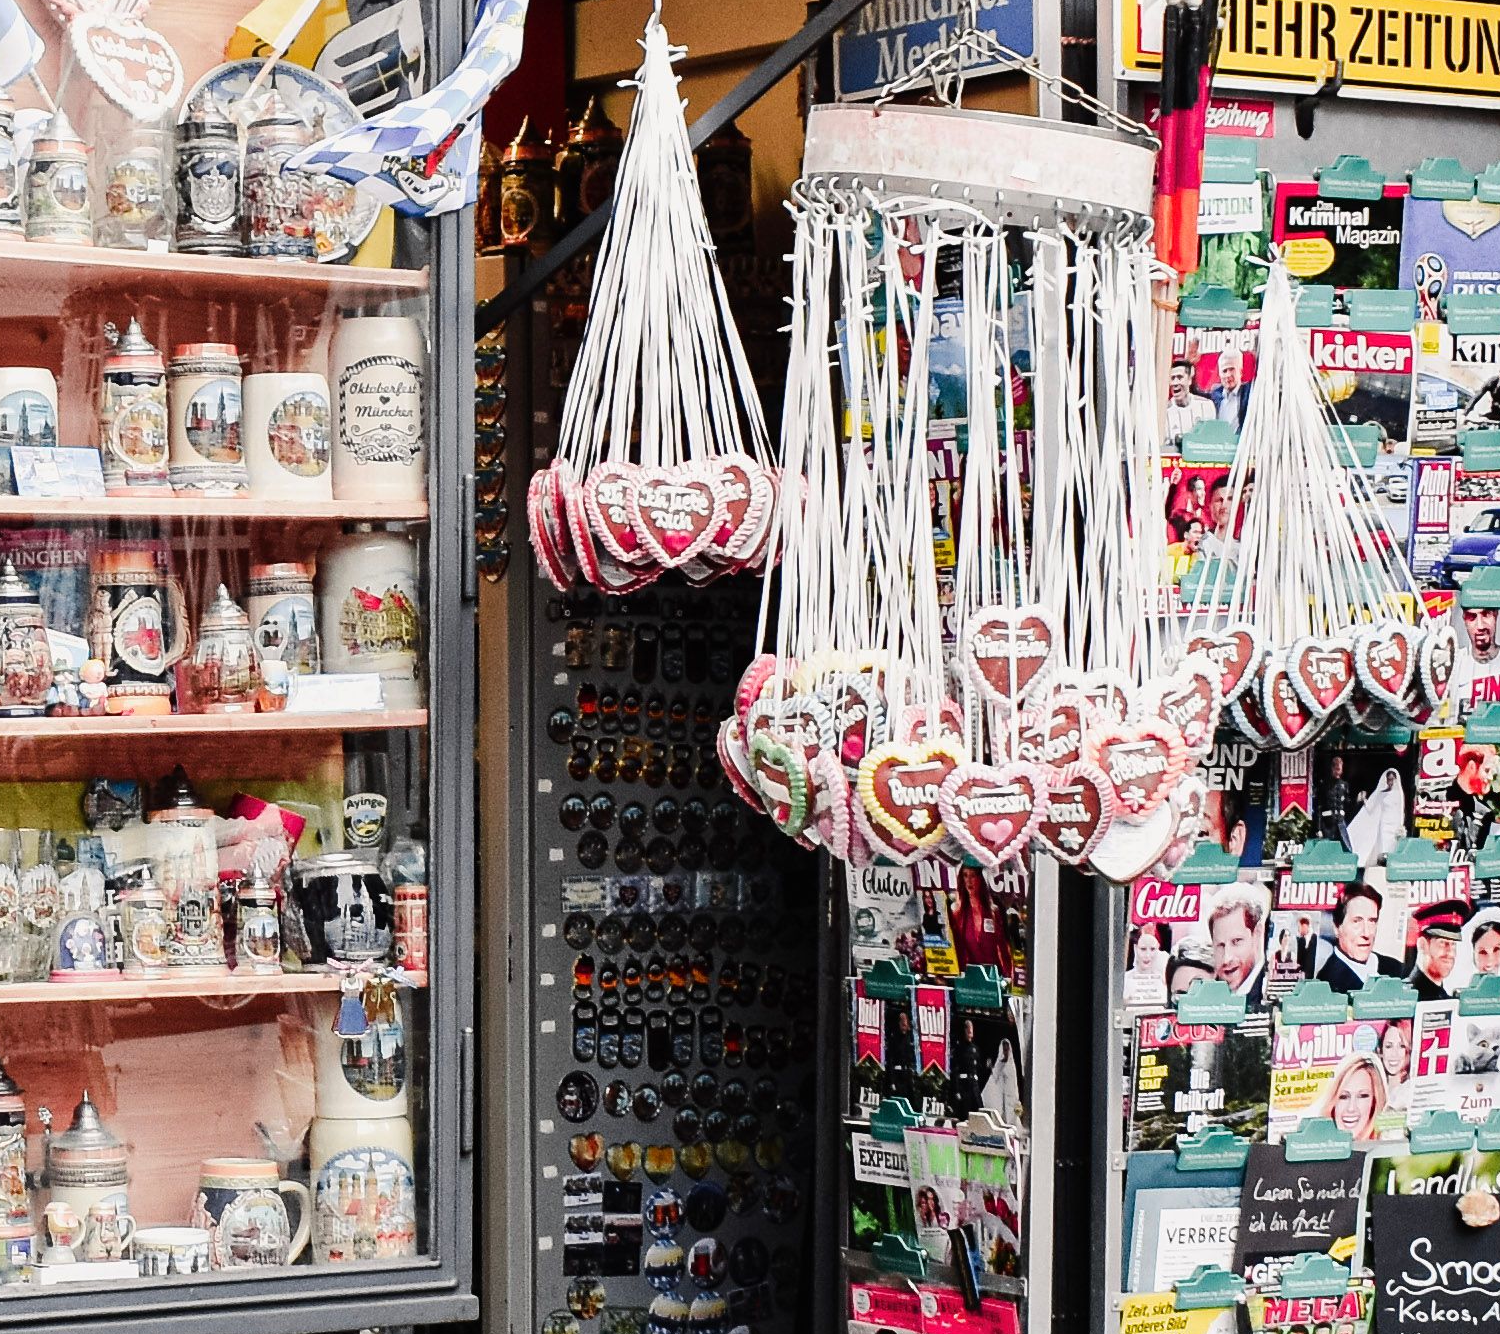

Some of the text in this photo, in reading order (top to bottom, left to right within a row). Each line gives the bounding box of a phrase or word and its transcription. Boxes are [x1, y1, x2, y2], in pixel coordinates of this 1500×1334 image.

[1289, 206, 1369, 226] Kriminal
[1336, 226, 1400, 249] Magazin
[1314, 333, 1411, 370] kicker
[350, 382, 416, 396] Oktoberfest
[355, 406, 413, 417] München
[1418, 465, 1449, 496] Auto
[863, 868, 910, 896] Gluten
[1136, 881, 1197, 918] Gala
[1461, 1094, 1492, 1109] Zum
[1166, 1226, 1240, 1244] VERBREC
[1128, 1303, 1150, 1318] Zeit,
[1264, 1292, 1359, 1326] MEGA
[1125, 1317, 1187, 1334] anderes Bild
